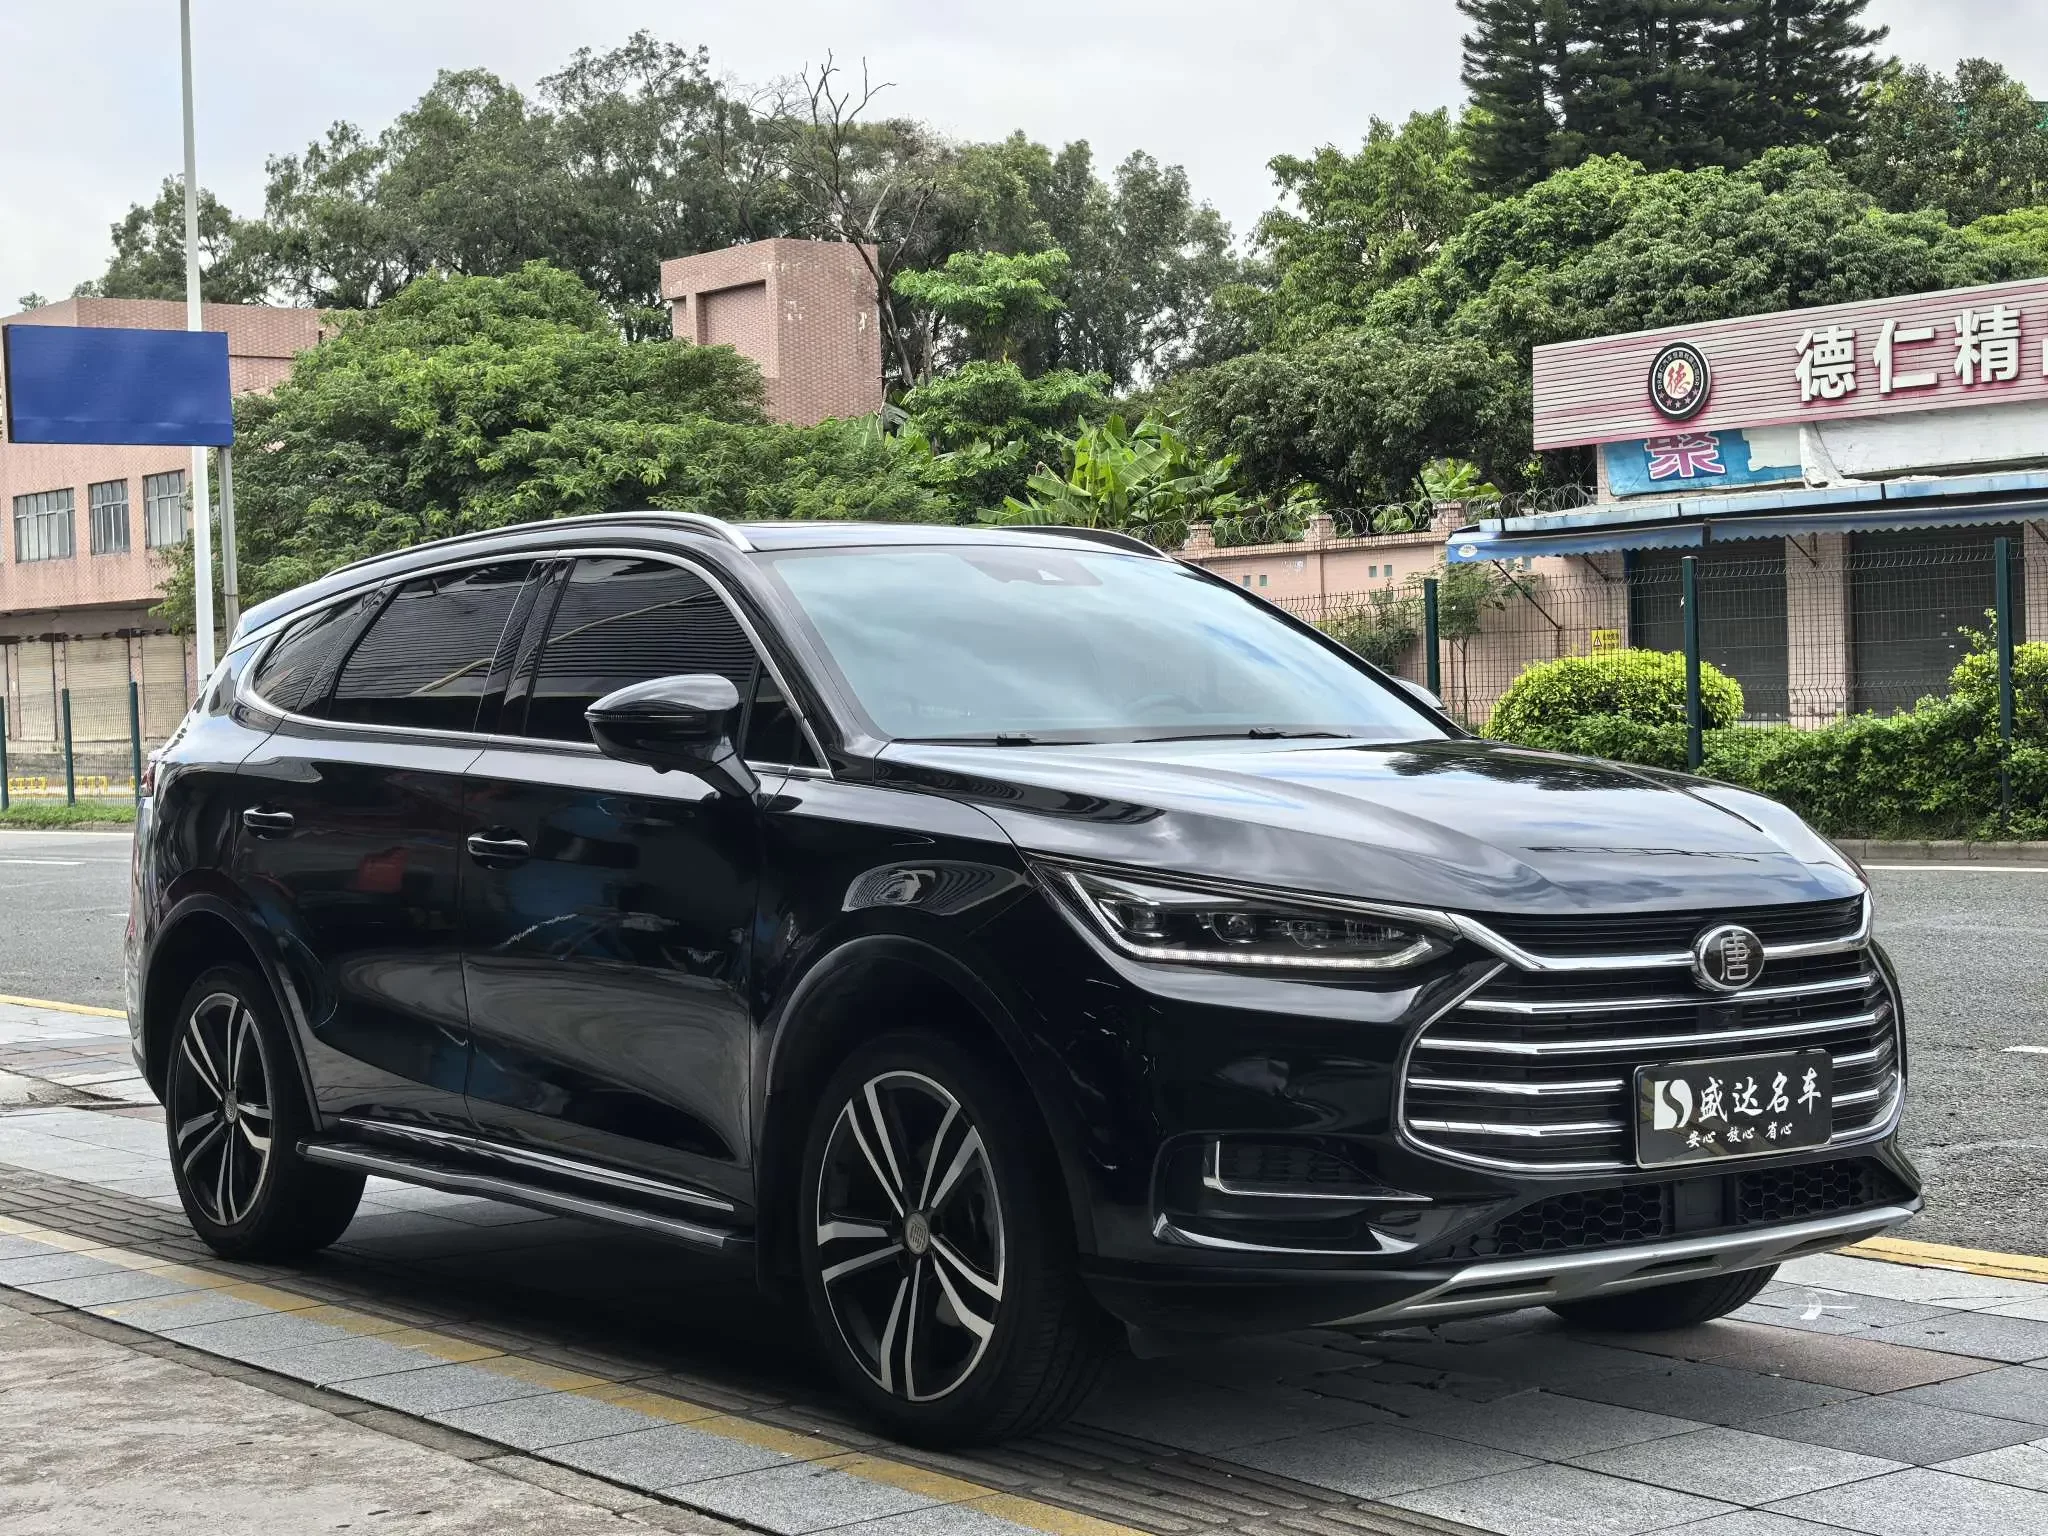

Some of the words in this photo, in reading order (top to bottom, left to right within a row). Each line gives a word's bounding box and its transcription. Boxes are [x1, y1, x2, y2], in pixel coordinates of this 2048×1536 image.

[1794, 304, 2048, 402] 德仁精
[1698, 1067, 1822, 1123] 盛达名车
[1686, 1130, 1716, 1148] 安心
[1726, 1126, 1755, 1143] 放心
[1765, 1121, 1793, 1140] 省心
